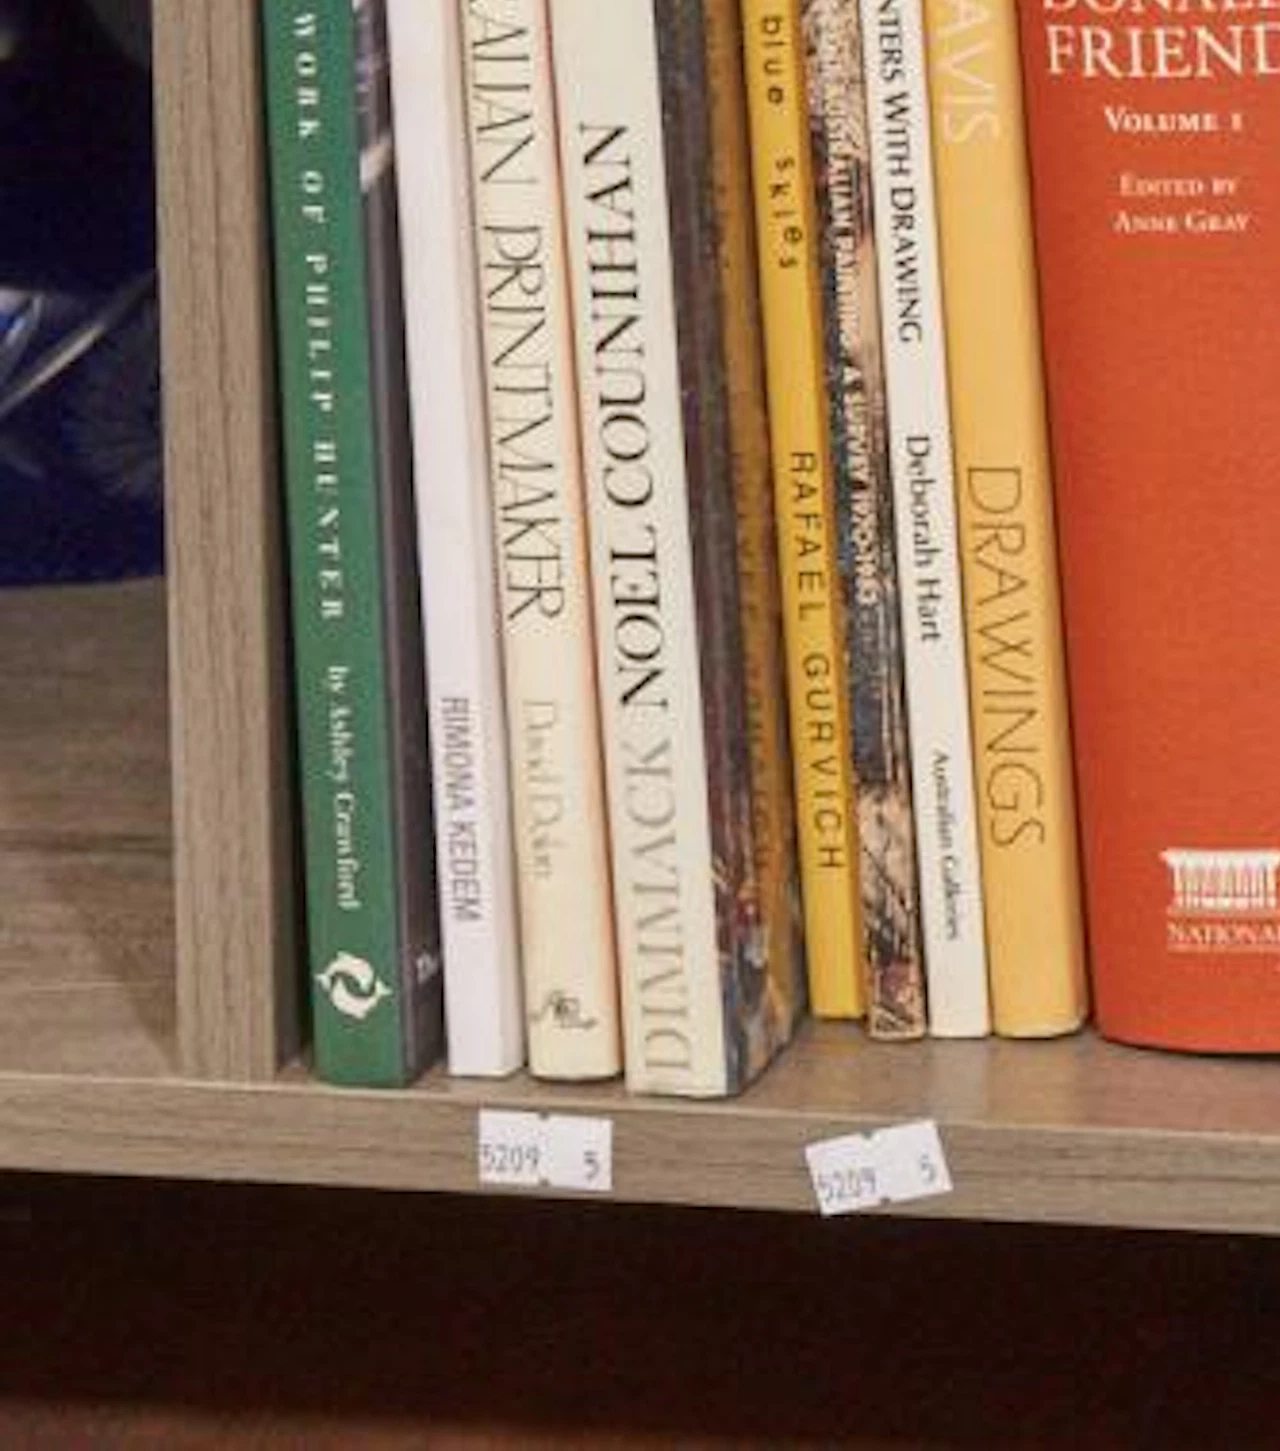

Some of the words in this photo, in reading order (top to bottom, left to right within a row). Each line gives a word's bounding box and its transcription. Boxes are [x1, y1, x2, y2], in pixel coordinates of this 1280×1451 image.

[294, 12, 321, 136] WORK
[761, 15, 787, 106] blue
[302, 169, 326, 224] OF
[885, 90, 914, 176] WITH
[769, 156, 806, 270] skies
[890, 186, 923, 344] DRAWING
[306, 253, 334, 411] PHILIP
[580, 121, 669, 509] COUNIHAN
[483, 225, 566, 621] PRINTMAKER
[313, 441, 343, 620] HUNTER
[789, 450, 826, 623] RAFAEL
[905, 435, 942, 567] Deborah
[612, 523, 668, 712] NOEL
[915, 578, 942, 644] Hart
[967, 464, 1045, 851] DRAWINGS
[323, 664, 351, 694] by
[441, 697, 476, 813] RIMONA
[803, 651, 848, 869] GURVICH
[449, 819, 481, 922] KEDEM
[625, 737, 693, 1079] DIMMACK
[482, 1144, 541, 1173] 5209
[582, 1151, 600, 1180] 5
